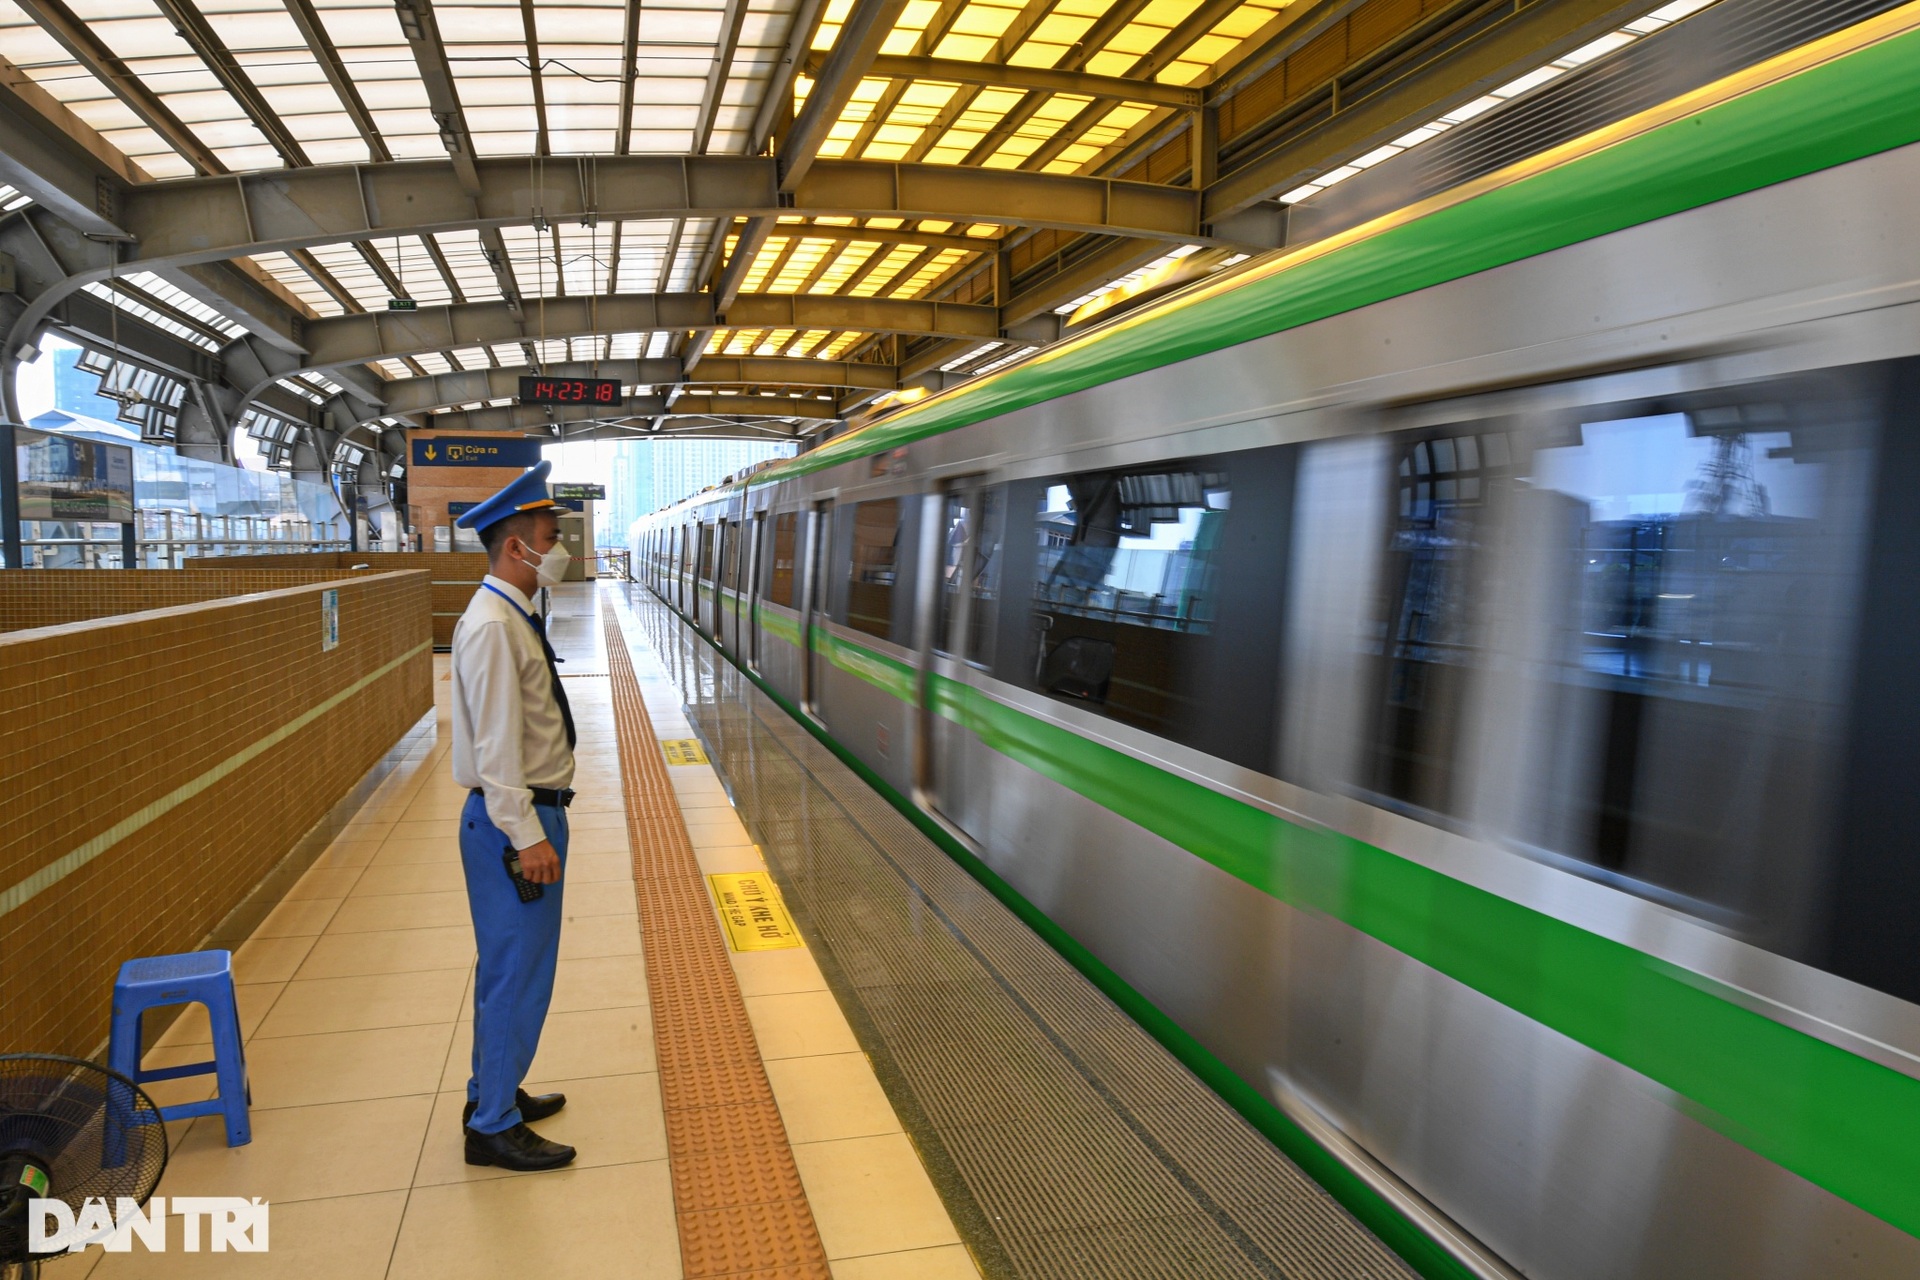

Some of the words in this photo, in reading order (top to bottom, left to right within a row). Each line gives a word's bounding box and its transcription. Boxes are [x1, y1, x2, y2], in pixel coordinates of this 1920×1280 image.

[738, 880, 765, 896] CHÚ
[723, 892, 737, 905] MIND
[728, 905, 741, 915] THE
[748, 904, 774, 923] KHE
[731, 915, 746, 927] GAP
[757, 925, 790, 939] HỞ
